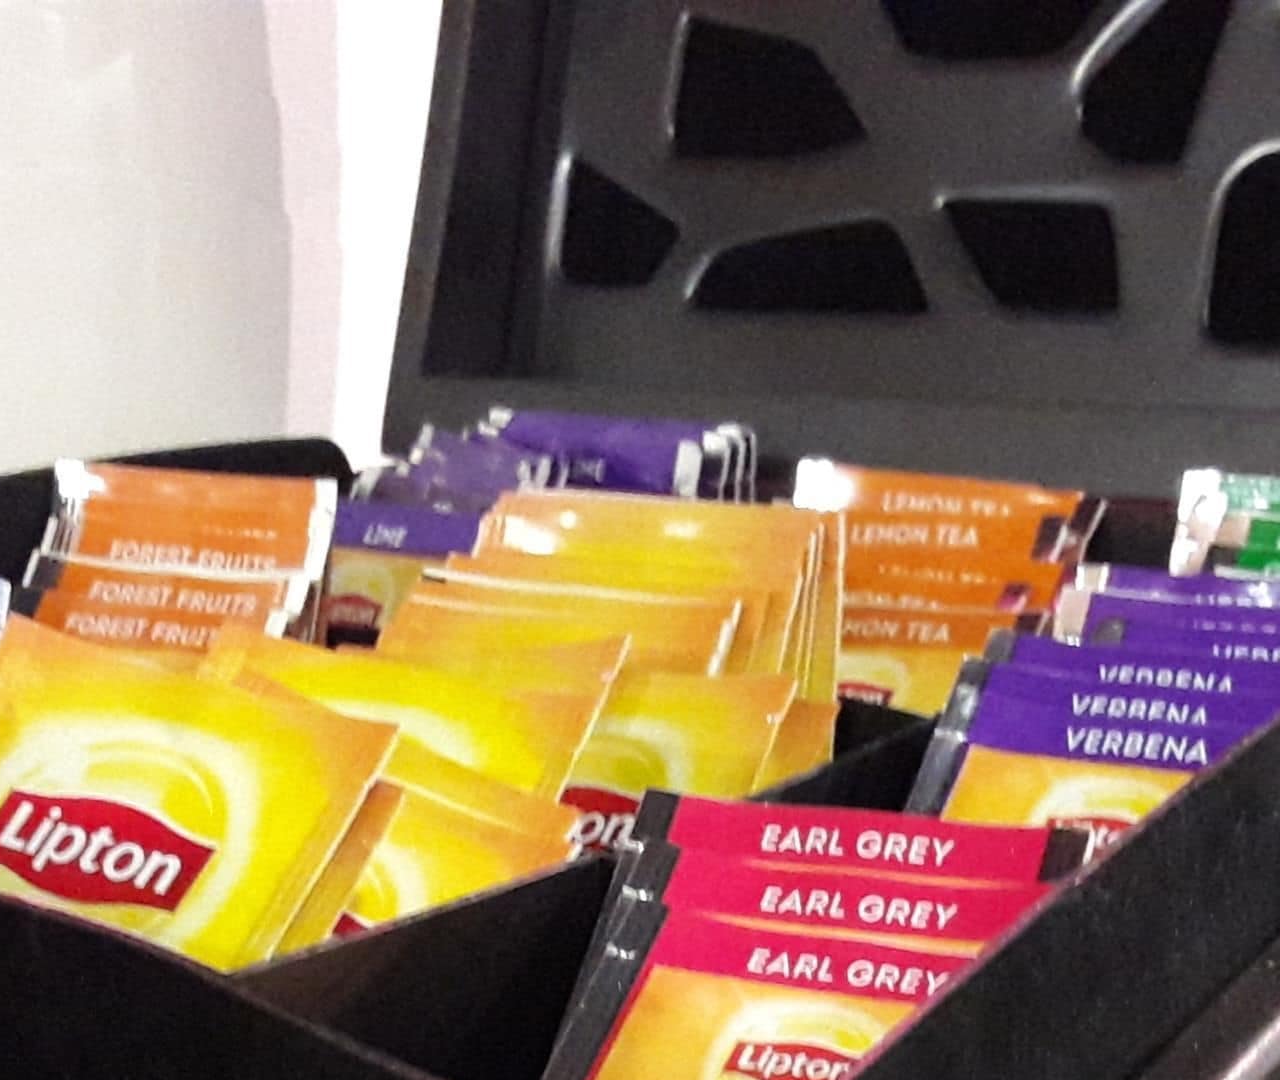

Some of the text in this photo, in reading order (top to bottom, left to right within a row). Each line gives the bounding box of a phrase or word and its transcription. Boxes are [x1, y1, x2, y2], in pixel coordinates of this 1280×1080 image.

[363, 522, 409, 549] LIME
[850, 522, 980, 546] LEMON TEA
[109, 539, 192, 566] FOREST
[88, 580, 258, 617] FOREST FRUITS
[64, 612, 149, 641] FOREST
[907, 622, 951, 644] TEA
[1066, 725, 1208, 765] VERBENA
[760, 823, 955, 867] EARL GREY
[759, 886, 959, 931] EARL GREY
[747, 946, 950, 997] EARL GREY
